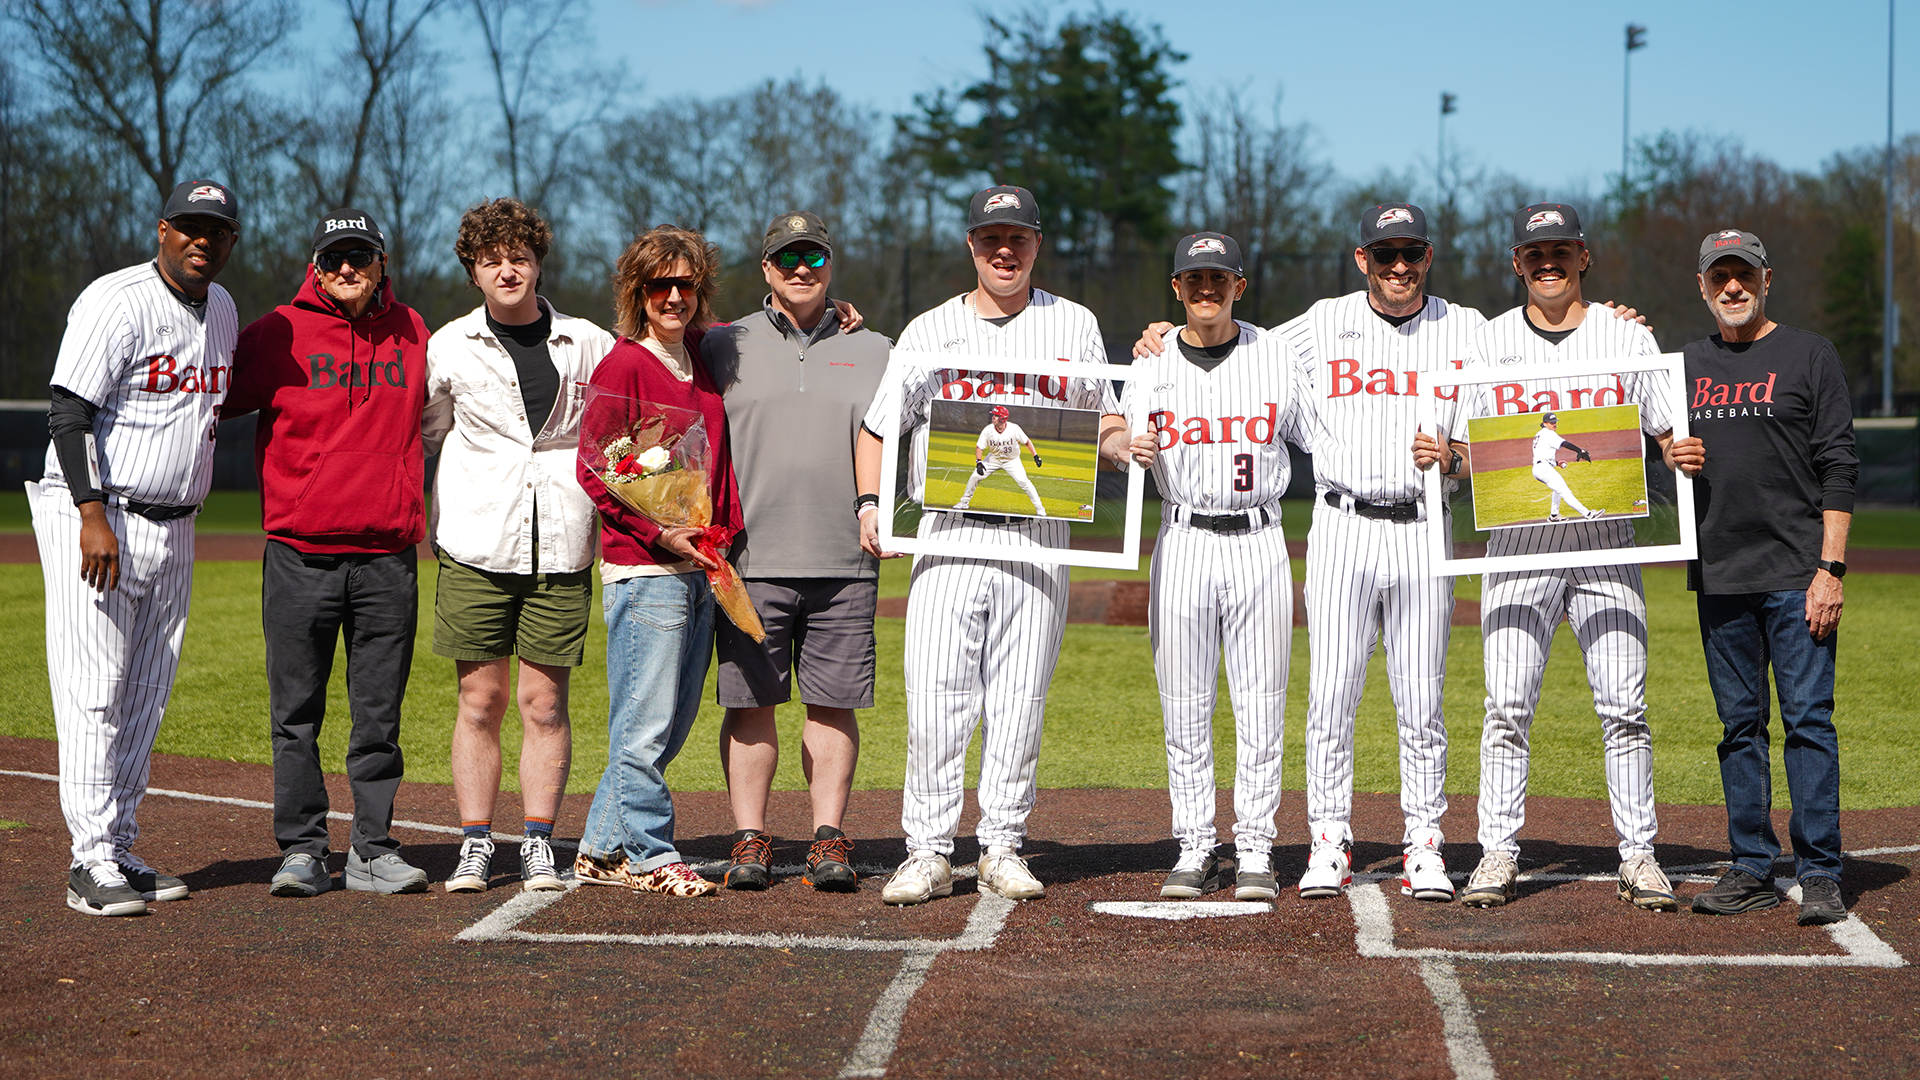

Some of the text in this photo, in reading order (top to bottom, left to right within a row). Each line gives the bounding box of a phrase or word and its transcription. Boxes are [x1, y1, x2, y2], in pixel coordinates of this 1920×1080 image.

[325, 217, 369, 234] Bard
[1715, 237, 1742, 249] Bard
[306, 349, 408, 390] Bard
[1492, 373, 1625, 416] Bard
[1691, 371, 1777, 409] Bard
[1147, 402, 1277, 452] Bard
[1233, 453, 1254, 492] 3
